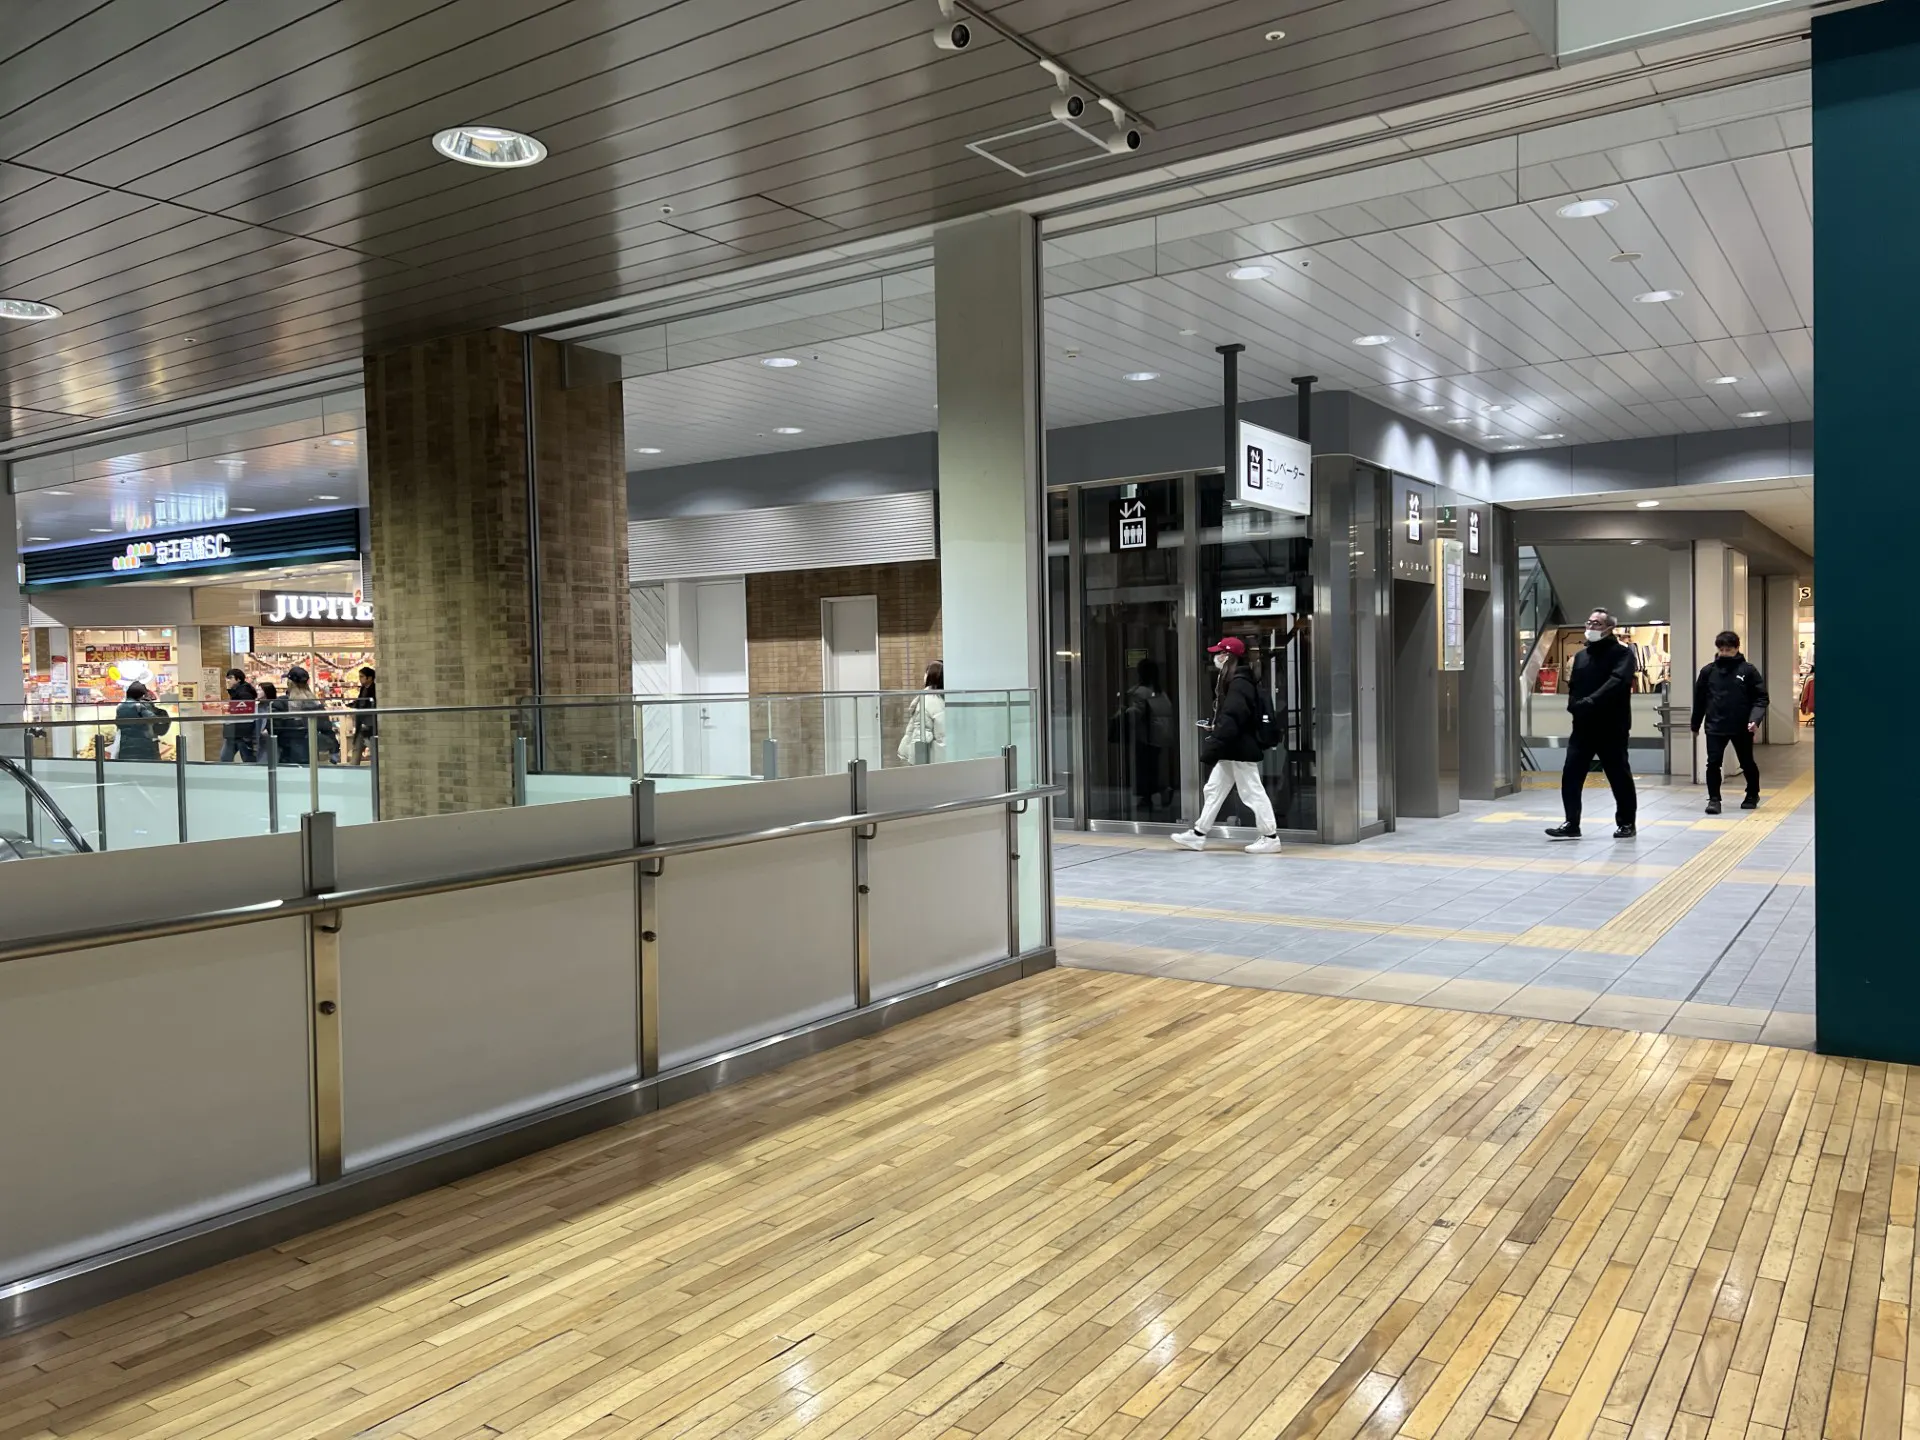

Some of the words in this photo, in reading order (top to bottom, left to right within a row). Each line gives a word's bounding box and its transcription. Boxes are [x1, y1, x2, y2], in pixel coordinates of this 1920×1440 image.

[1267, 458, 1305, 480] エレベーター
[155, 533, 231, 565] 京王高幡SC
